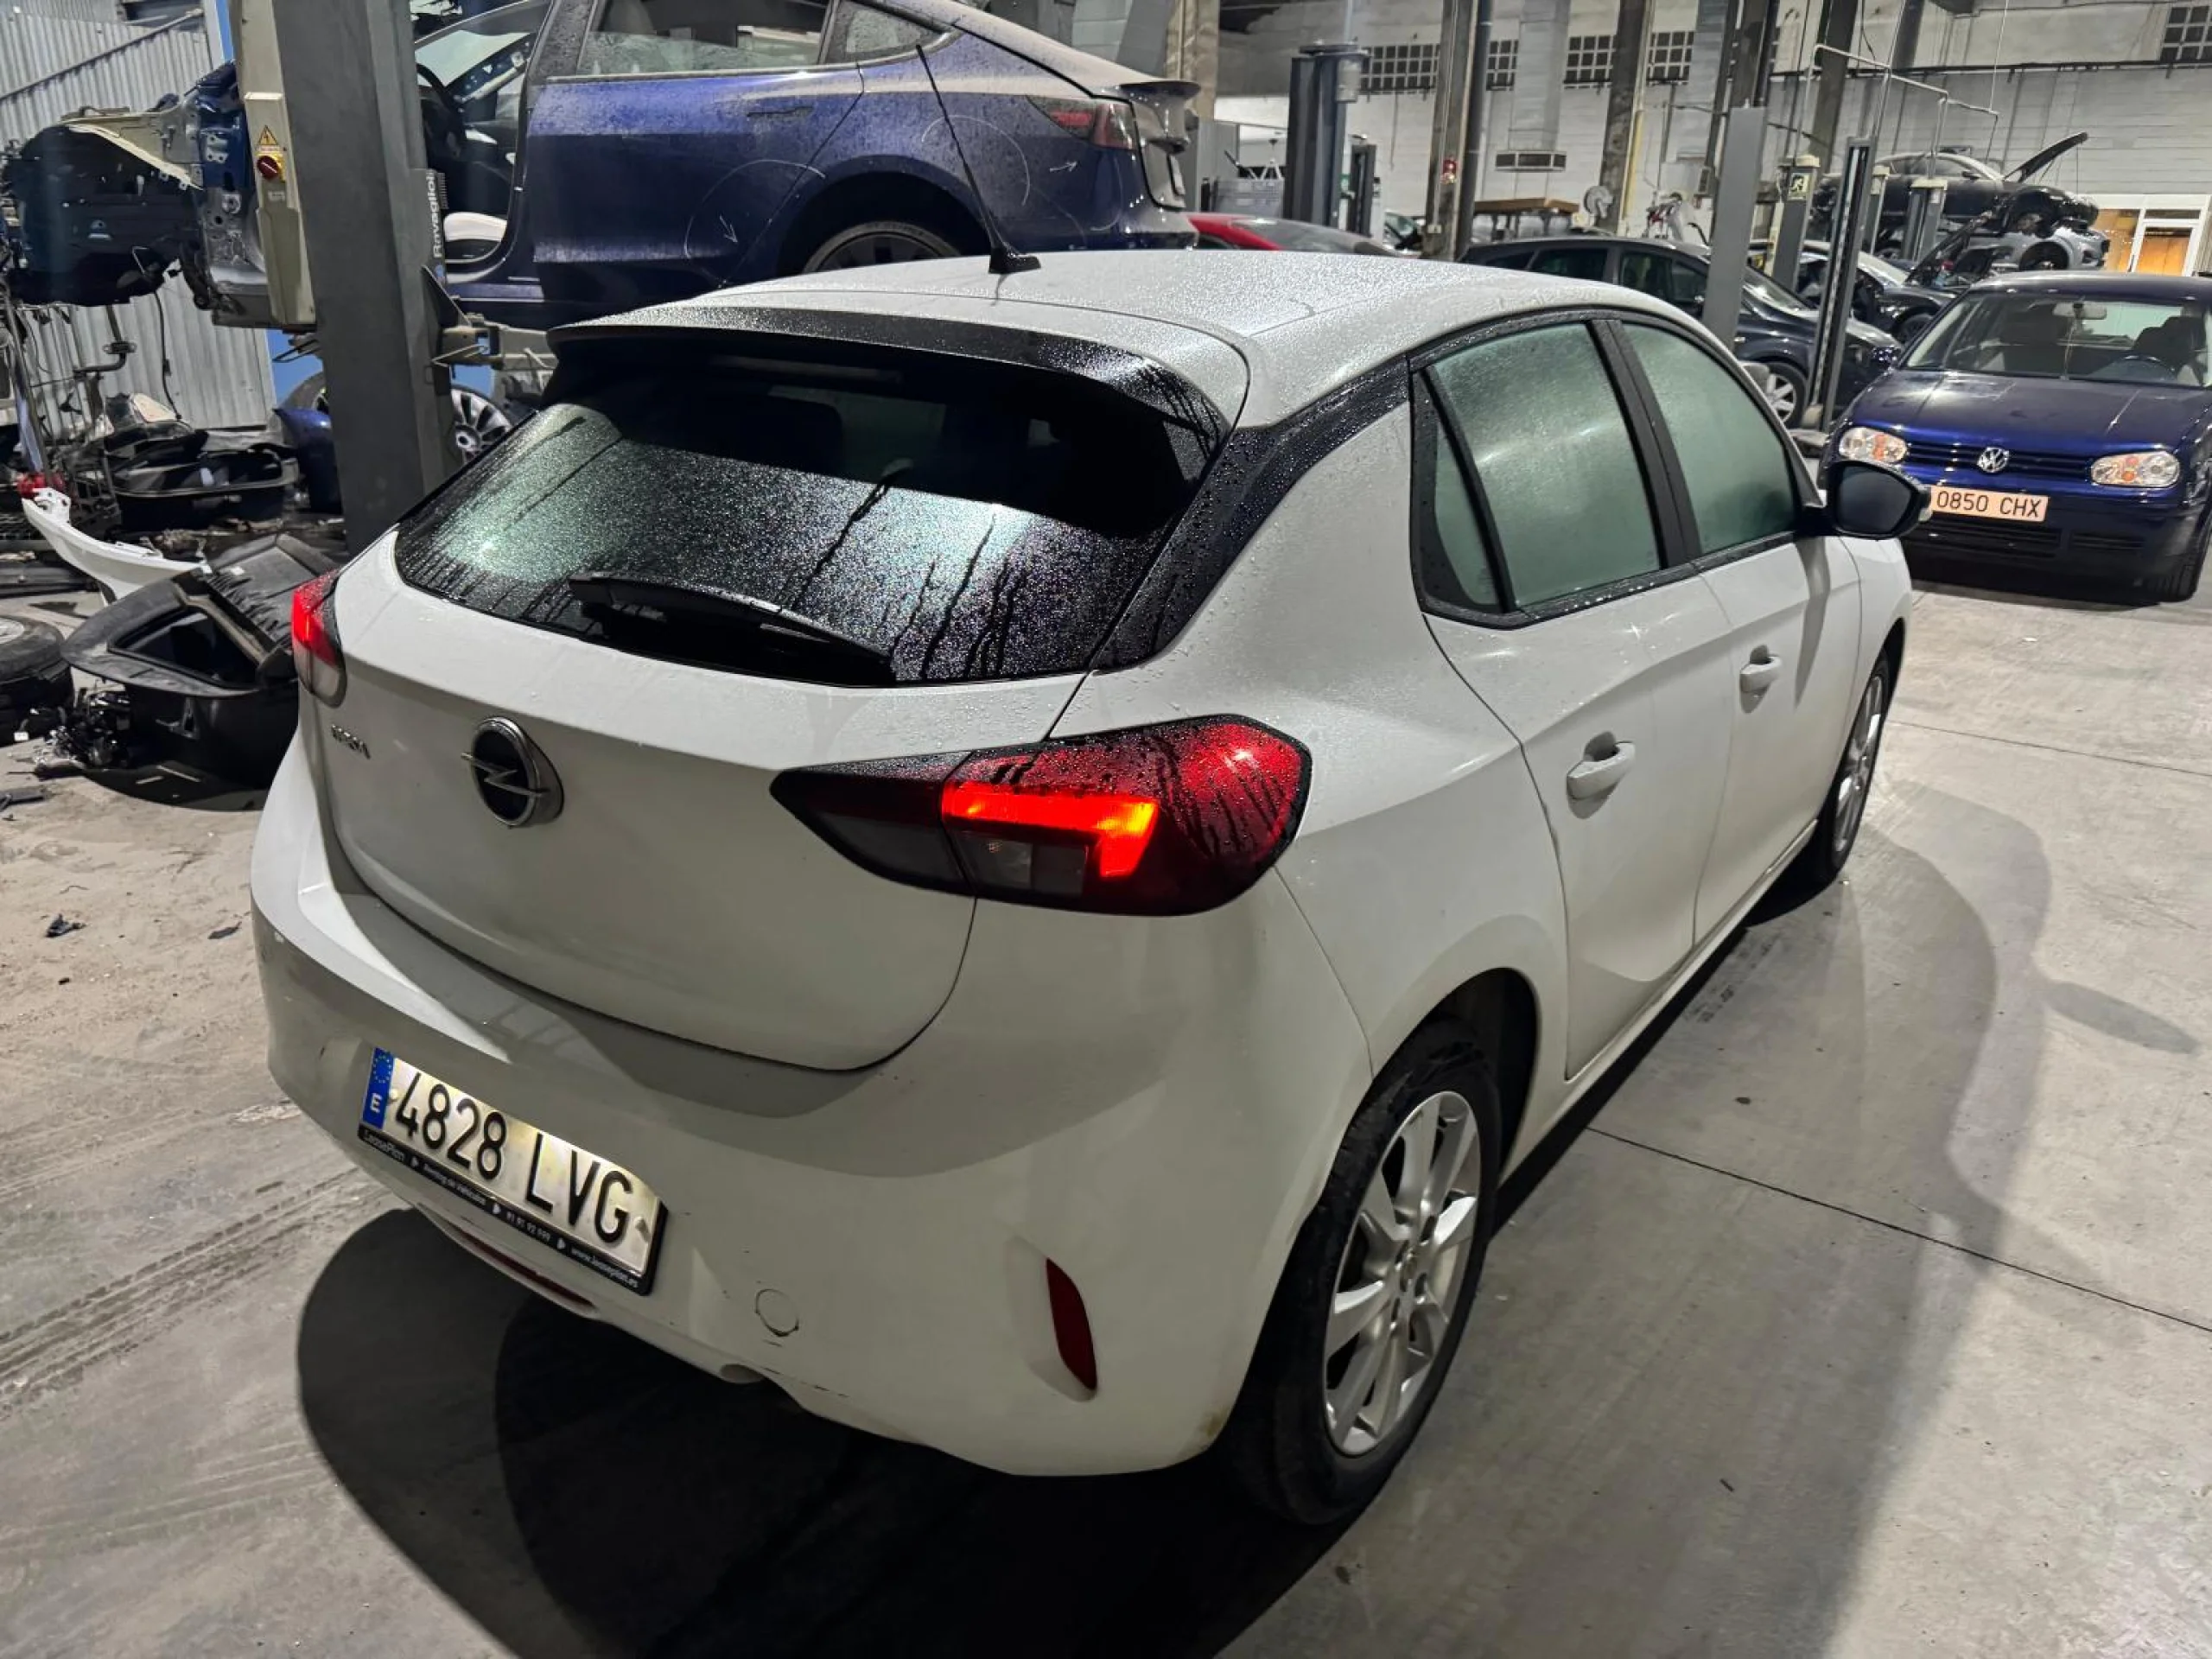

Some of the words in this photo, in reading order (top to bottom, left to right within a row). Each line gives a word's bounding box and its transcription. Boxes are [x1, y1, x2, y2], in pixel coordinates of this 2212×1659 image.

[1936, 490, 1990, 512] 0850
[1999, 496, 2042, 518] CHX
[369, 1092, 382, 1113] E
[396, 1071, 507, 1181] 4828
[525, 1132, 632, 1244] LVG
